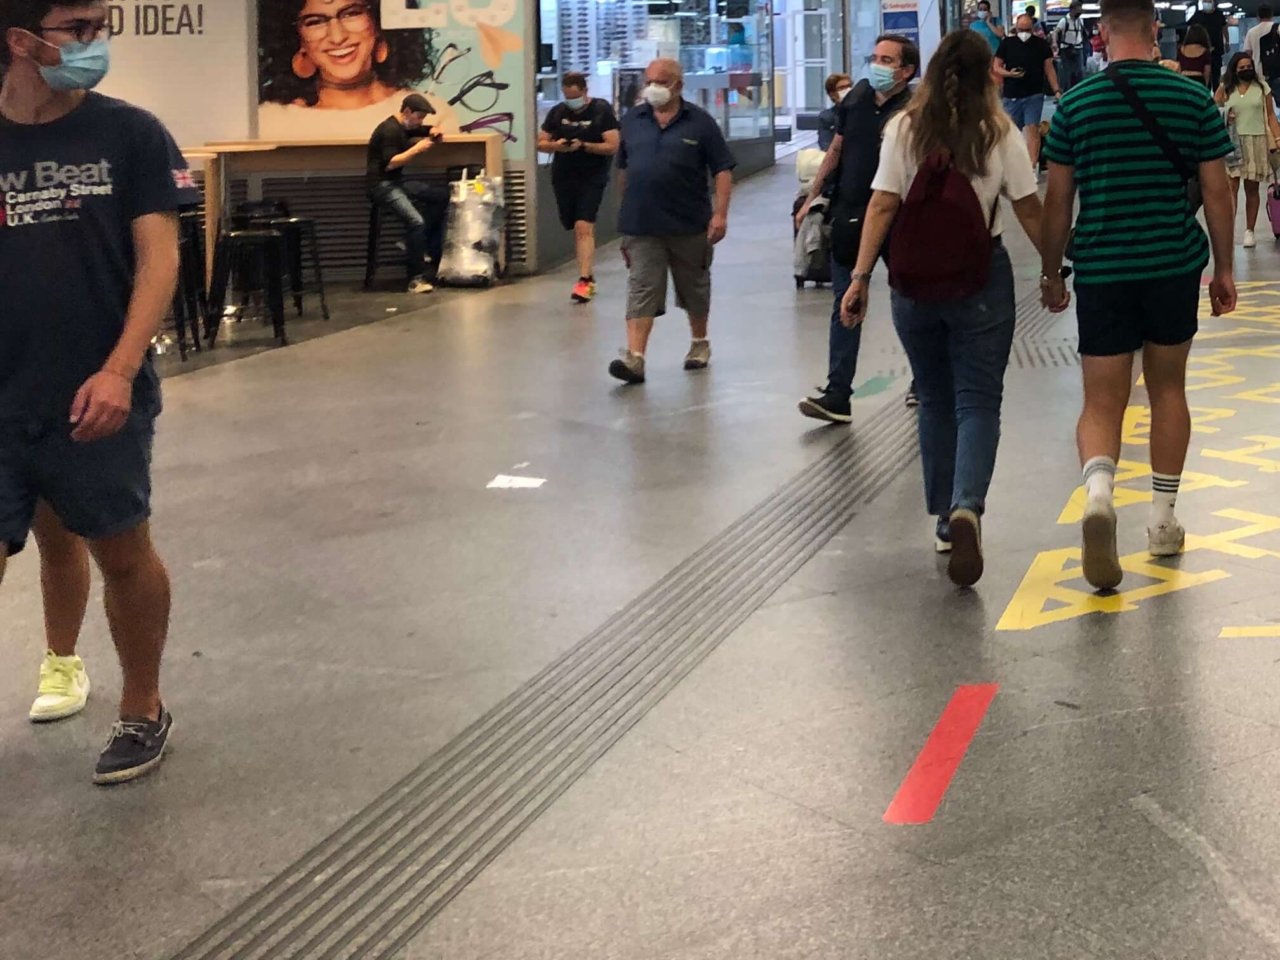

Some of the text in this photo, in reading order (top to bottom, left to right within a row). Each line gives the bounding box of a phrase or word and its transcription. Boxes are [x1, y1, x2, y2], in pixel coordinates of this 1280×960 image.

[135, 4, 203, 35] IDEA!
[34, 158, 113, 188] Beat
[5, 183, 113, 203] Carnaby Street
[6, 199, 62, 214] London
